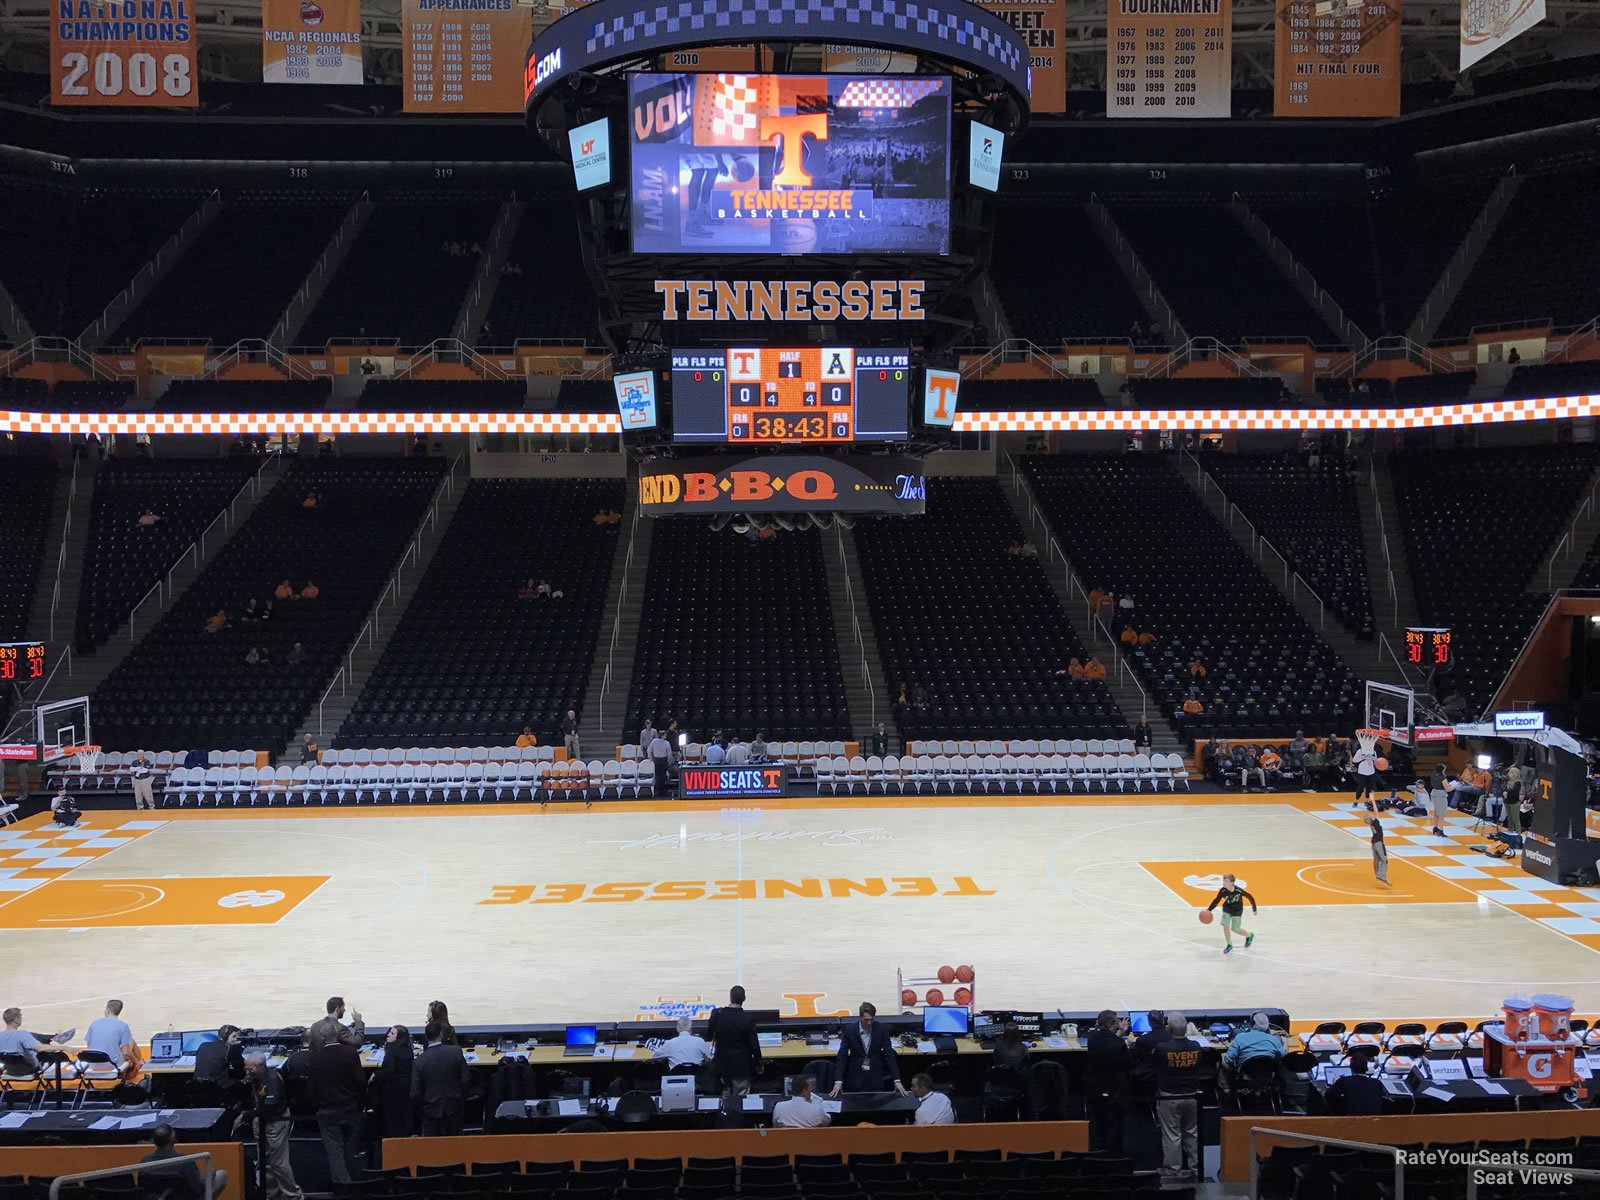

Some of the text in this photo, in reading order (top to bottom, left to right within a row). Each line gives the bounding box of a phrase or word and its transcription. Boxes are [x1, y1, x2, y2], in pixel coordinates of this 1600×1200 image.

[59, 0, 189, 19] NATIONAL
[419, 0, 511, 10] APPEARANCES
[1120, 0, 1221, 14] TOURNAMENT
[1290, 5, 1386, 15] 1945 2013
[1290, 19, 1309, 28] 1969
[1341, 19, 1361, 28] 2003
[59, 22, 189, 41] CHAMPIONS
[264, 31, 361, 43] NCAA REGIONALS
[1116, 28, 1224, 38] 1967 1982 2001 2011
[1290, 32, 1361, 40] 1971 1990 2004
[285, 45, 341, 55] 1982 2004
[826, 45, 841, 54] SEC
[1116, 42, 1224, 51] 1976 1983 2006 2014
[1290, 45, 1360, 53] 1984 1992 2012
[285, 56, 342, 67] 1983 2005
[673, 54, 699, 65] 2010
[856, 57, 880, 66] 2004
[1030, 57, 1052, 67] 2014
[1116, 55, 1196, 65] 1977 1989 2007
[61, 52, 191, 96] 2008
[286, 67, 309, 78] 1984
[1116, 69, 1196, 79] 1979 1998 2008
[1297, 63, 1380, 74] NIT FINAL FOUR
[1116, 83, 1196, 92] 1980 1999 2009
[1289, 82, 1308, 91] 1969
[1116, 96, 1196, 106] 1981 2000 2010
[1289, 94, 1308, 103] 1985
[760, 112, 828, 187] T
[50, 160, 76, 175] 317A
[288, 168, 308, 178] 318
[434, 168, 453, 178] 319
[1011, 169, 1029, 180] 323
[1148, 169, 1167, 180] 324
[730, 190, 854, 210] TENNESSEE
[718, 209, 866, 219] BASKETBALL
[654, 280, 925, 320] TENNESSEE
[672, 357, 724, 367] PLR FLS PTS
[780, 352, 801, 361] HALF
[857, 356, 908, 366] PLR FLS PTS
[734, 352, 755, 374] T
[827, 353, 845, 374] A
[787, 363, 794, 378] 1
[879, 371, 902, 381] 0 0
[694, 371, 720, 382] 0 0
[740, 388, 750, 402] 0
[767, 394, 776, 405] 4
[806, 394, 814, 405] 4
[831, 387, 841, 402] 0
[929, 376, 958, 419] T
[733, 414, 748, 422] FLS
[833, 413, 848, 422] FLS
[733, 426, 741, 436] 0
[756, 417, 824, 438] 38:43
[837, 425, 846, 436] 0
[895, 474, 918, 500] The
[1406, 631, 1451, 644] 38:43 38:43
[27, 647, 45, 659] 38:43
[1409, 644, 1447, 663] 30 30
[0, 658, 43, 679] 30 30
[1499, 717, 1536, 727] verizon
[684, 770, 762, 789] VIVIDSEATS
[1538, 778, 1553, 801] T
[1525, 849, 1552, 866] verizon
[474, 876, 999, 905] TENNESSEE
[1558, 1017, 1567, 1026] G
[1167, 1051, 1198, 1060] EVENT
[1167, 1060, 1198, 1068] STAFF
[1527, 1053, 1552, 1079] G
[1432, 1067, 1461, 1075] verizon
